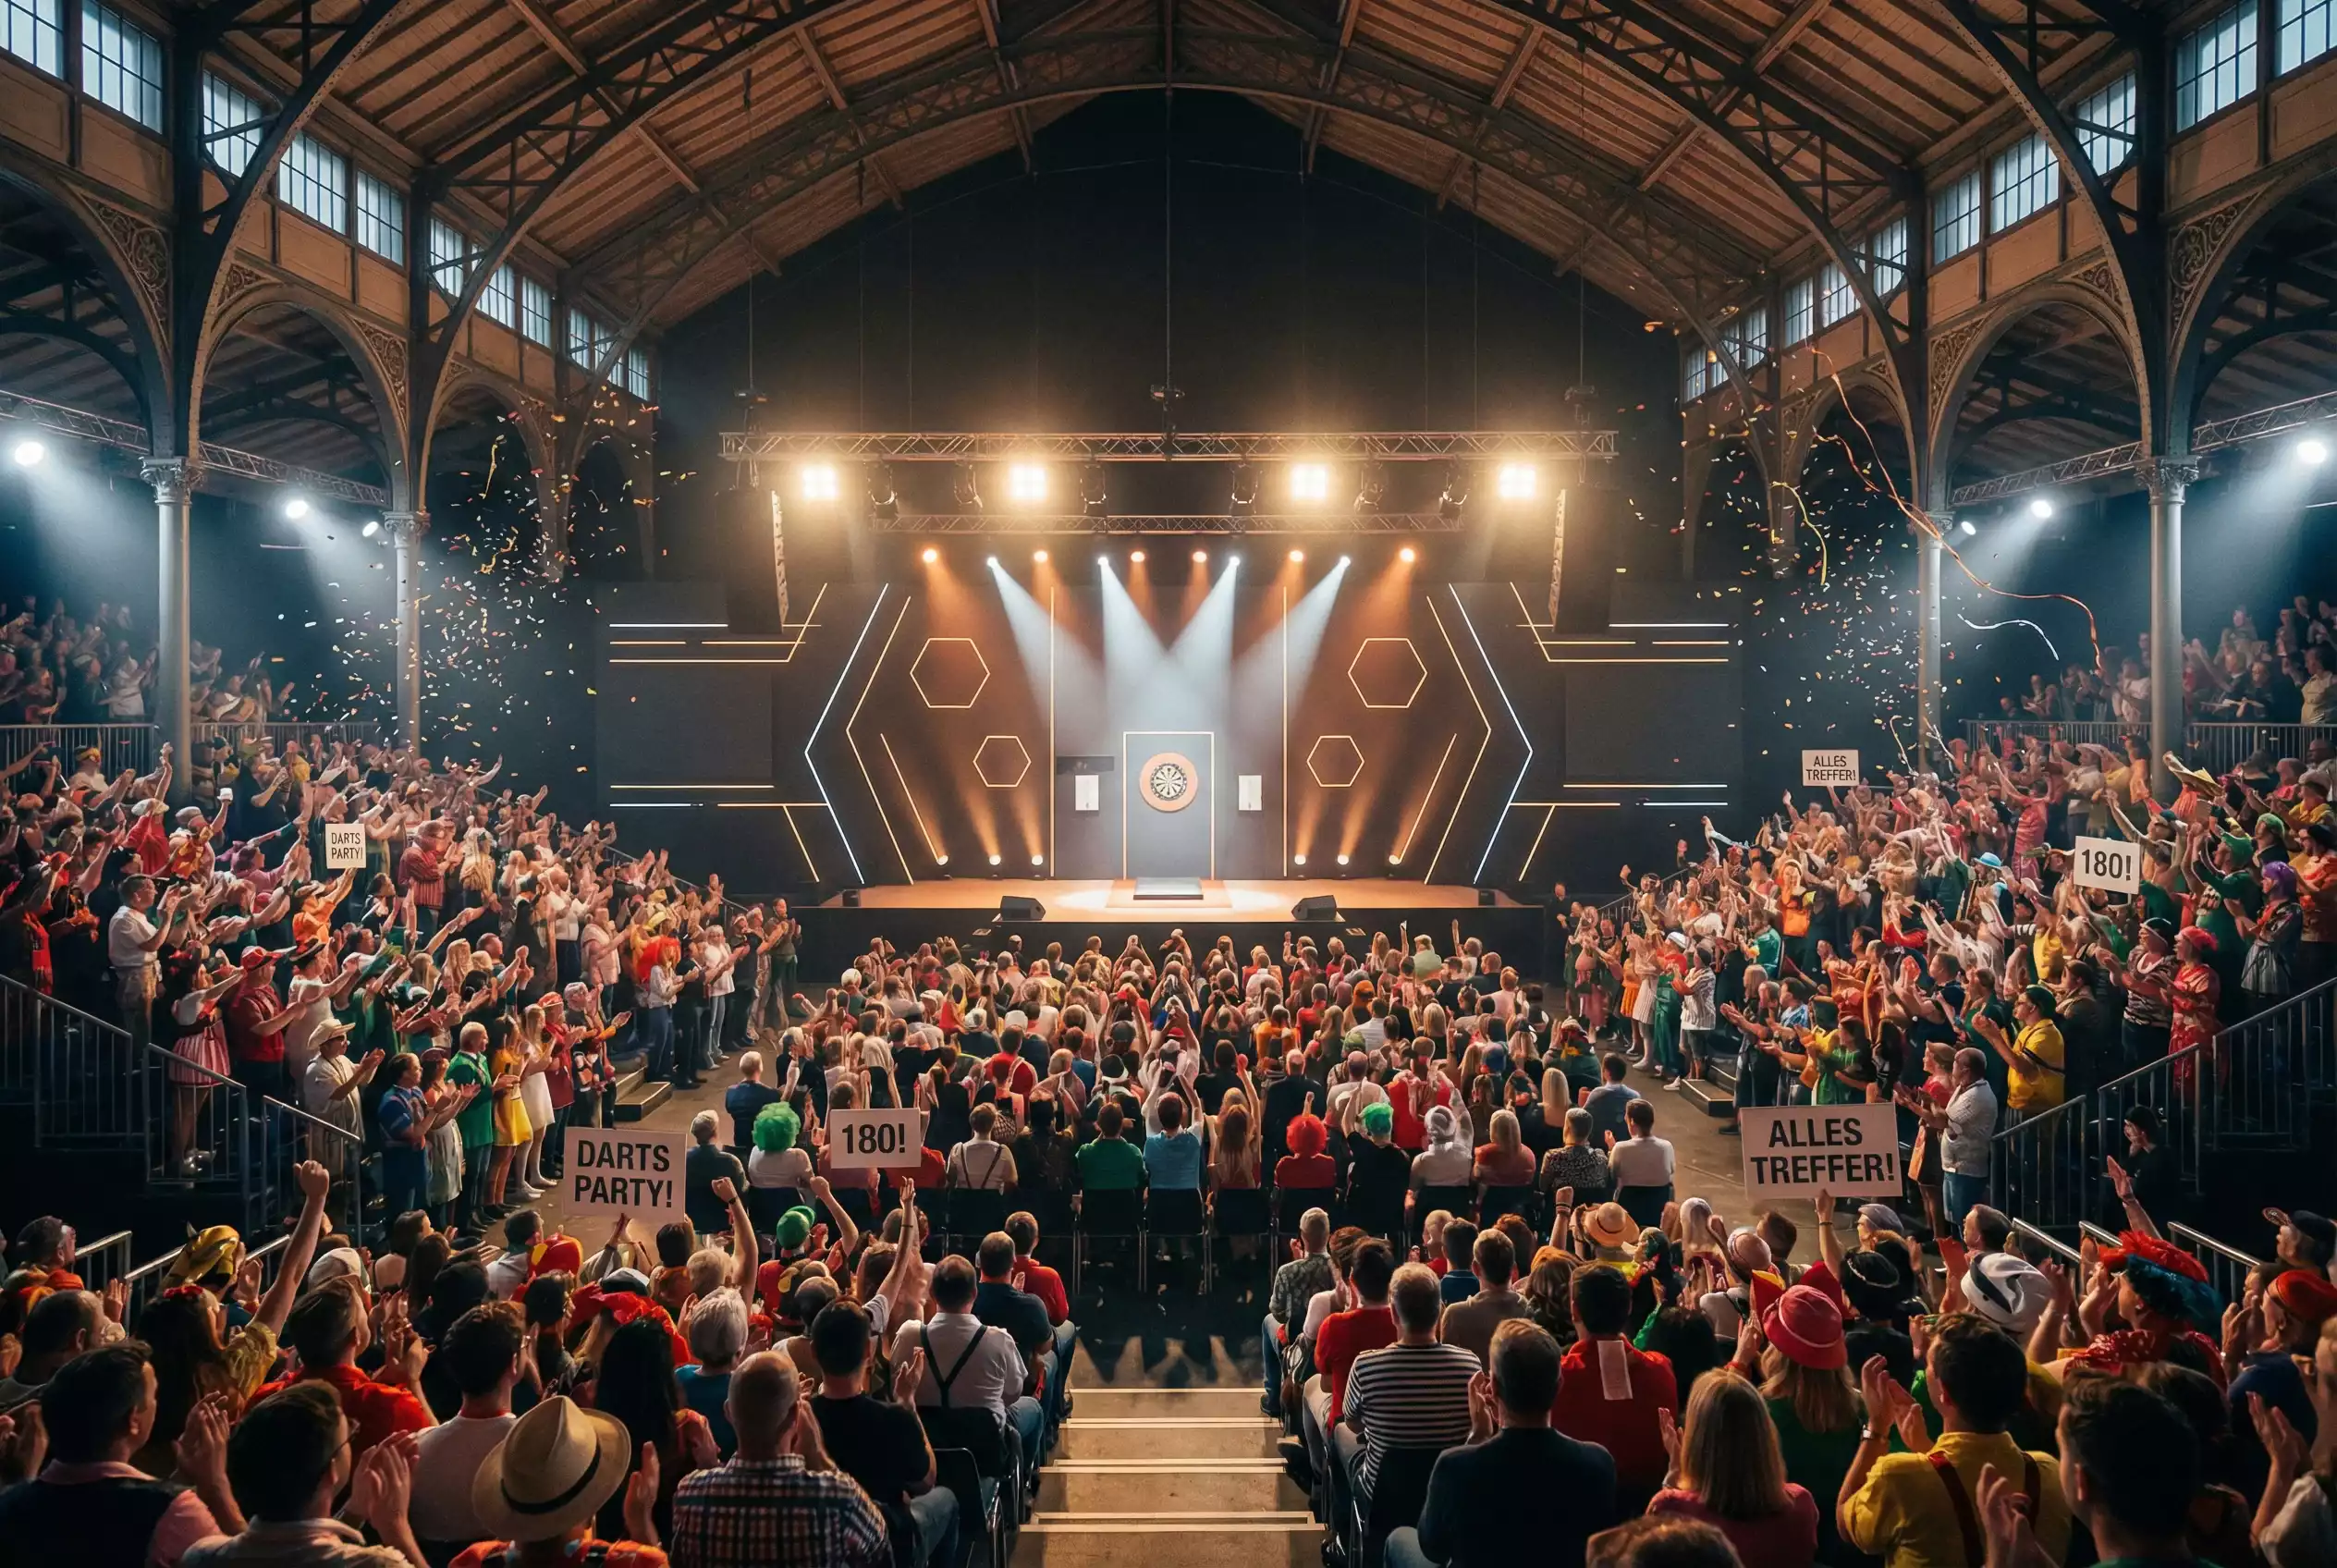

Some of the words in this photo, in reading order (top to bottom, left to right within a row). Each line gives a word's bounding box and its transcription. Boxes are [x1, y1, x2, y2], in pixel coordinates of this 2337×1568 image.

[1805, 768, 1856, 781] TREFFER!
[1813, 755, 1847, 767] ALLES
[331, 832, 361, 845] DARTS
[331, 847, 363, 860] PARTY!
[2081, 849, 2132, 881] 180!
[841, 1122, 906, 1154] 180!
[1768, 1117, 1863, 1148] ALLES
[577, 1139, 670, 1172] DARTS
[1750, 1153, 1895, 1184] TREFFER!
[574, 1174, 673, 1208] PARTY!
